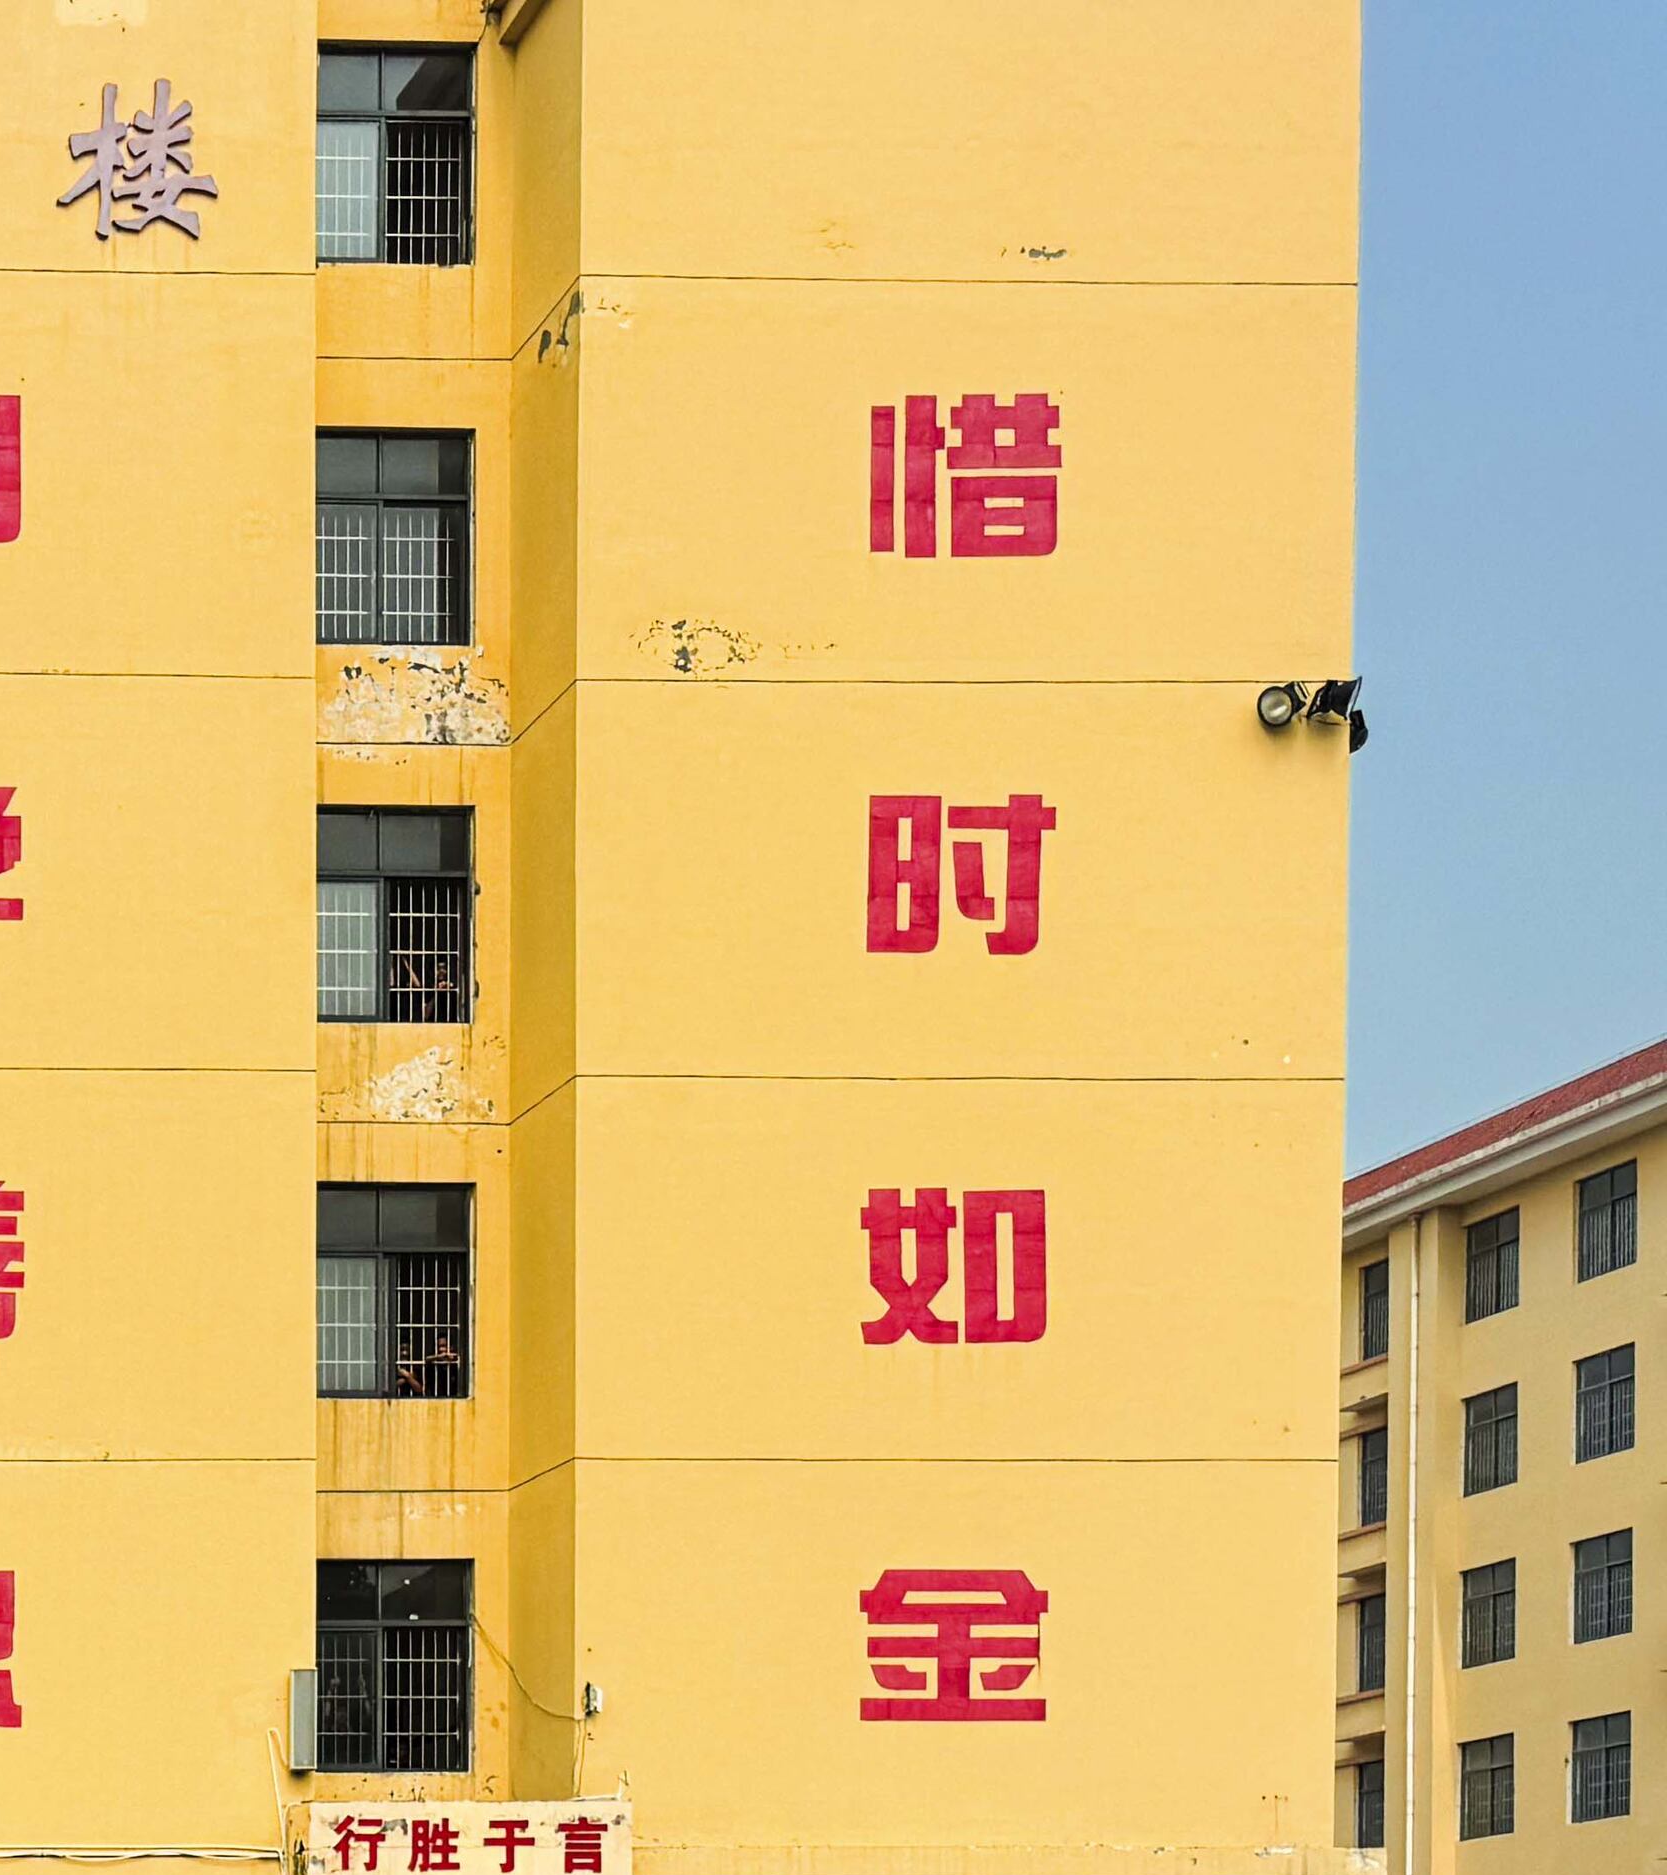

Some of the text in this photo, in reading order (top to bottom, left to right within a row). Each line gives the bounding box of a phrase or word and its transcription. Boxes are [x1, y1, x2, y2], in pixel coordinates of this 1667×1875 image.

[861, 395, 1062, 1722] 惜时如金
[334, 1815, 607, 1874] 行胜于言
